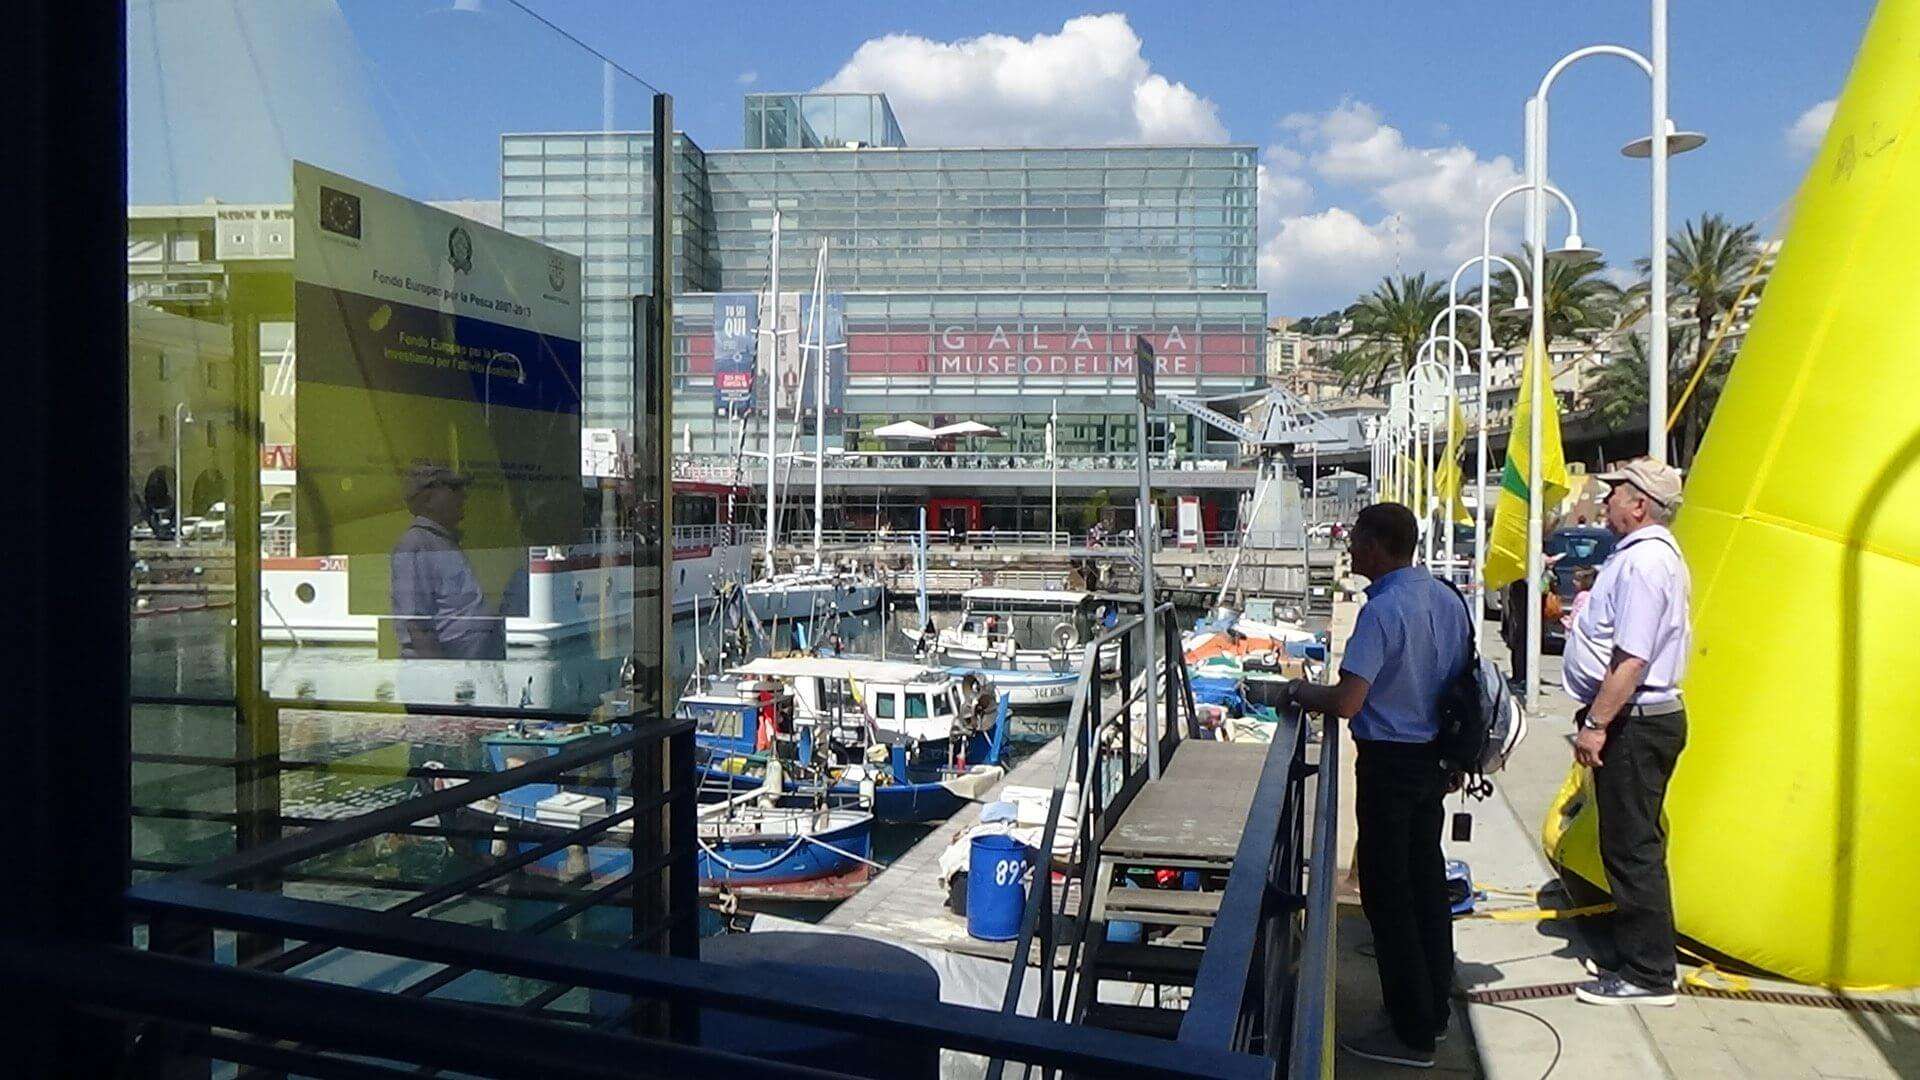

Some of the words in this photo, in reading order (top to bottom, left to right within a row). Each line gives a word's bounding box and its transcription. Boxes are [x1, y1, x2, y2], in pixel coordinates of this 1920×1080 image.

[373, 269, 403, 288] Fondo
[405, 277, 443, 298] Europeo
[460, 291, 468, 303] la
[470, 292, 493, 309] Pesca
[724, 317, 746, 338] QUI
[942, 324, 1187, 350] GALATA
[1114, 355, 1187, 374] MRE
